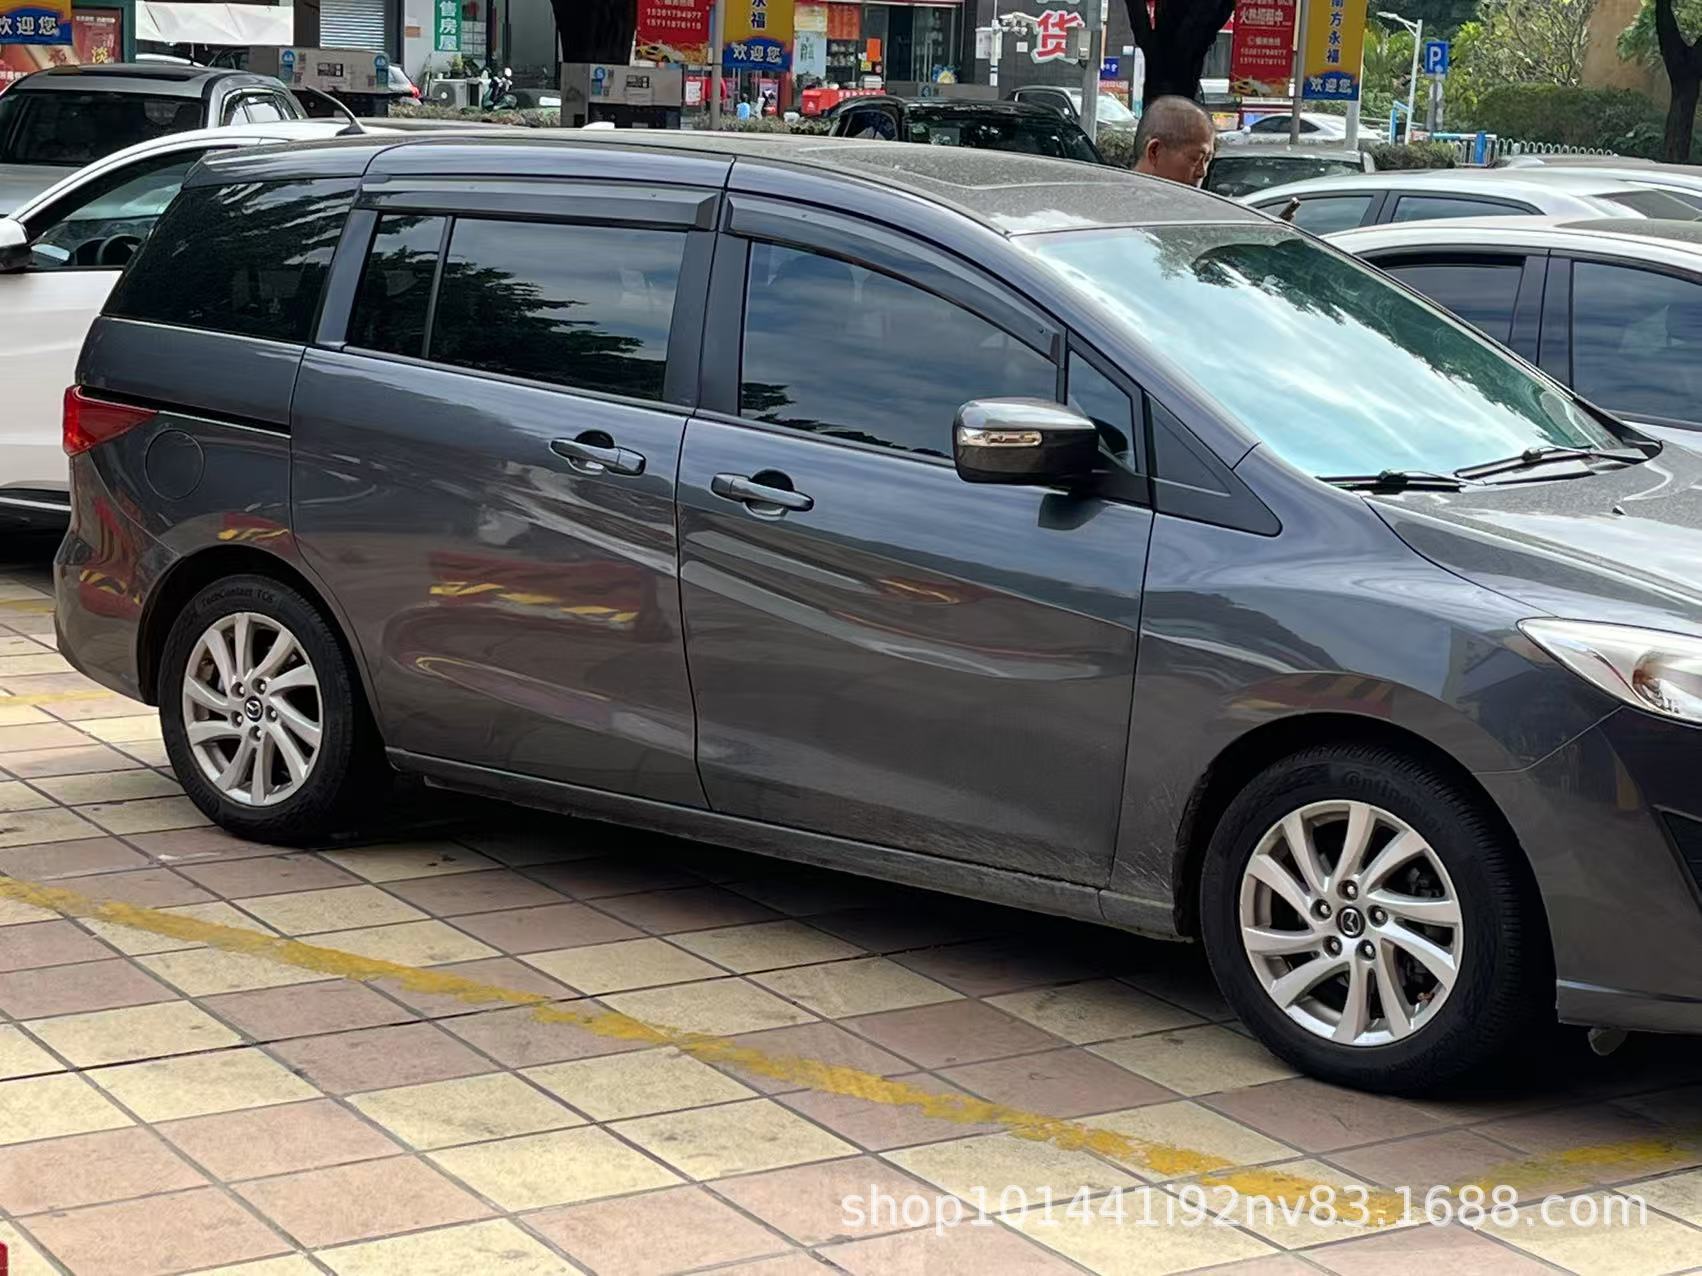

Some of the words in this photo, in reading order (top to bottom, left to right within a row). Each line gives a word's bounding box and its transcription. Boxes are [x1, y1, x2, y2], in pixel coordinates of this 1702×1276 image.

[0, 16, 57, 36] 欢迎您
[1033, 10, 1084, 63] 货
[732, 42, 782, 64] 欢迎您
[1430, 46, 1441, 70] P
[1311, 77, 1352, 93] 欢迎您
